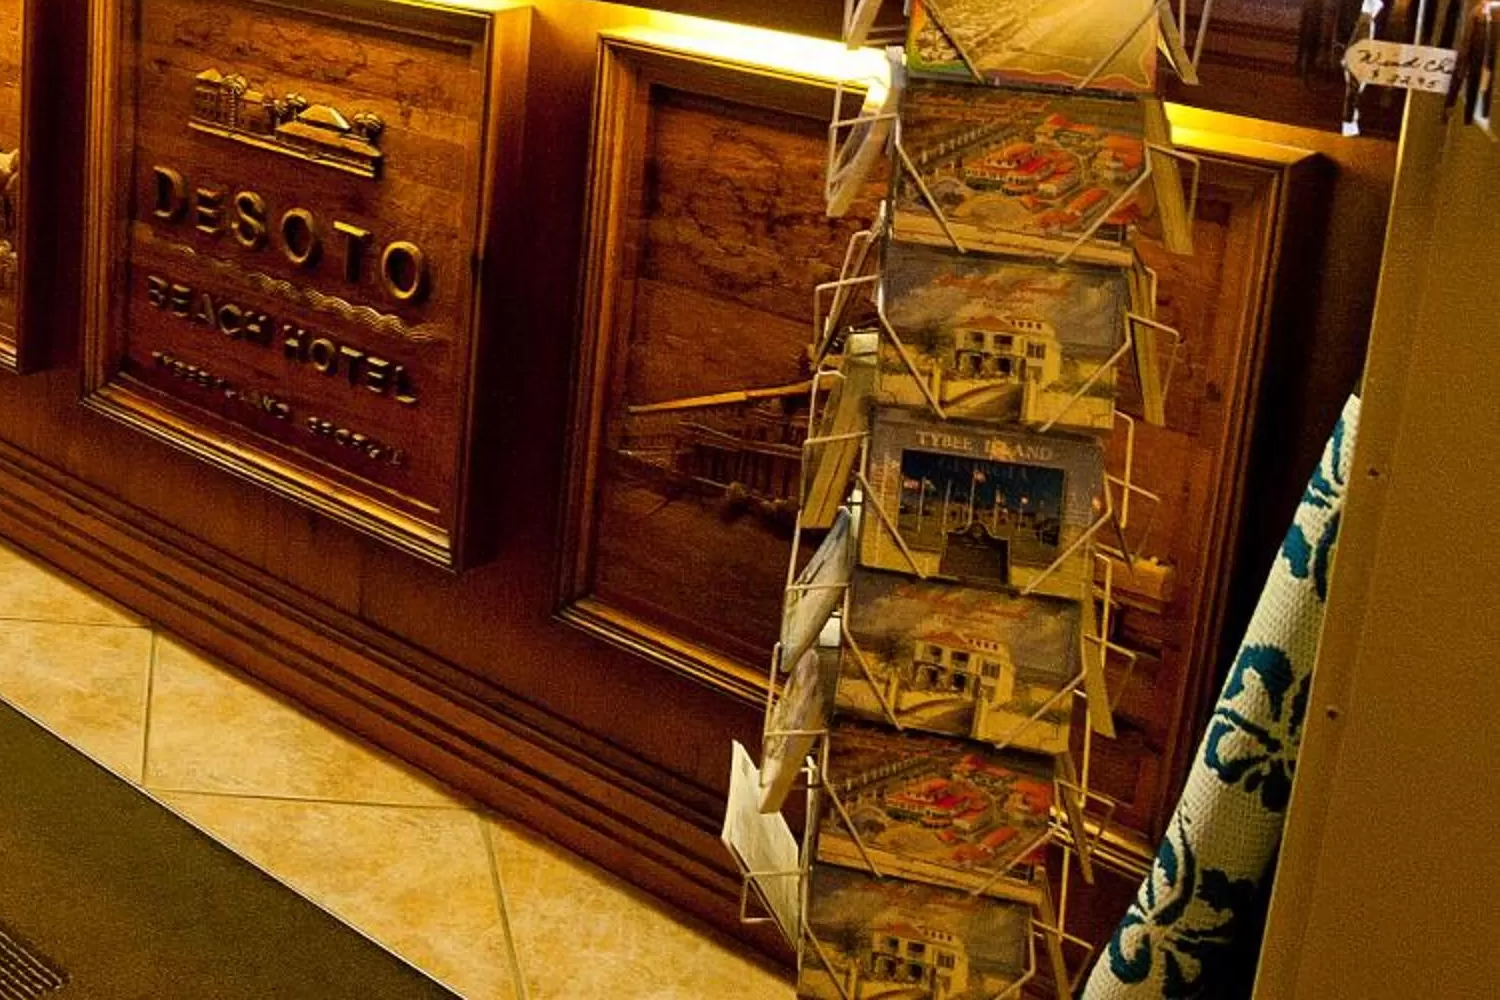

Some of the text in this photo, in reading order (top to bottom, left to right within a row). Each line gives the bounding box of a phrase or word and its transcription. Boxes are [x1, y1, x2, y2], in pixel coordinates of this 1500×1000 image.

[153, 165, 428, 302] DESOTO
[148, 275, 419, 405] BEACH HOTEL
